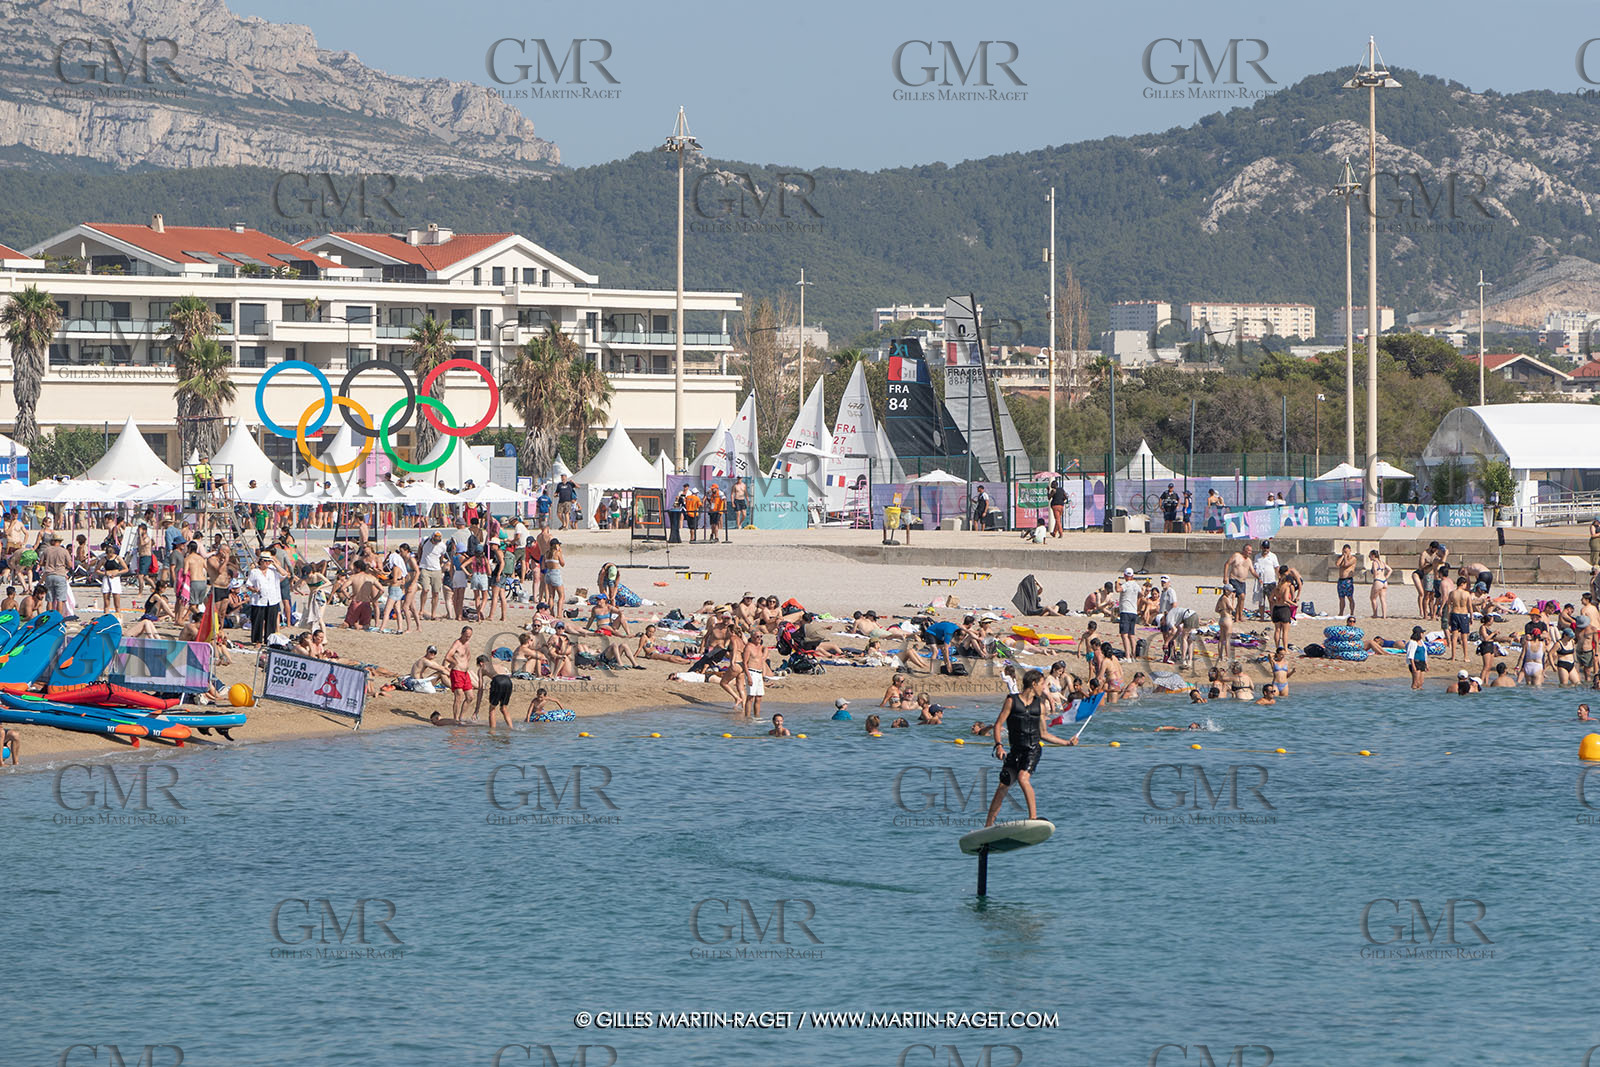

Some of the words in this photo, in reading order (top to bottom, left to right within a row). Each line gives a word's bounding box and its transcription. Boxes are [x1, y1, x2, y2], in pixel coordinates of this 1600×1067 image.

[889, 384, 910, 394] FRA
[888, 398, 908, 410] 84
[836, 424, 856, 434] FRA
[833, 436, 846, 445] 27
[1449, 510, 1472, 518] PARIS
[1449, 518, 1472, 526] 2024
[274, 657, 298, 670] HAVE
[300, 662, 306, 671] A
